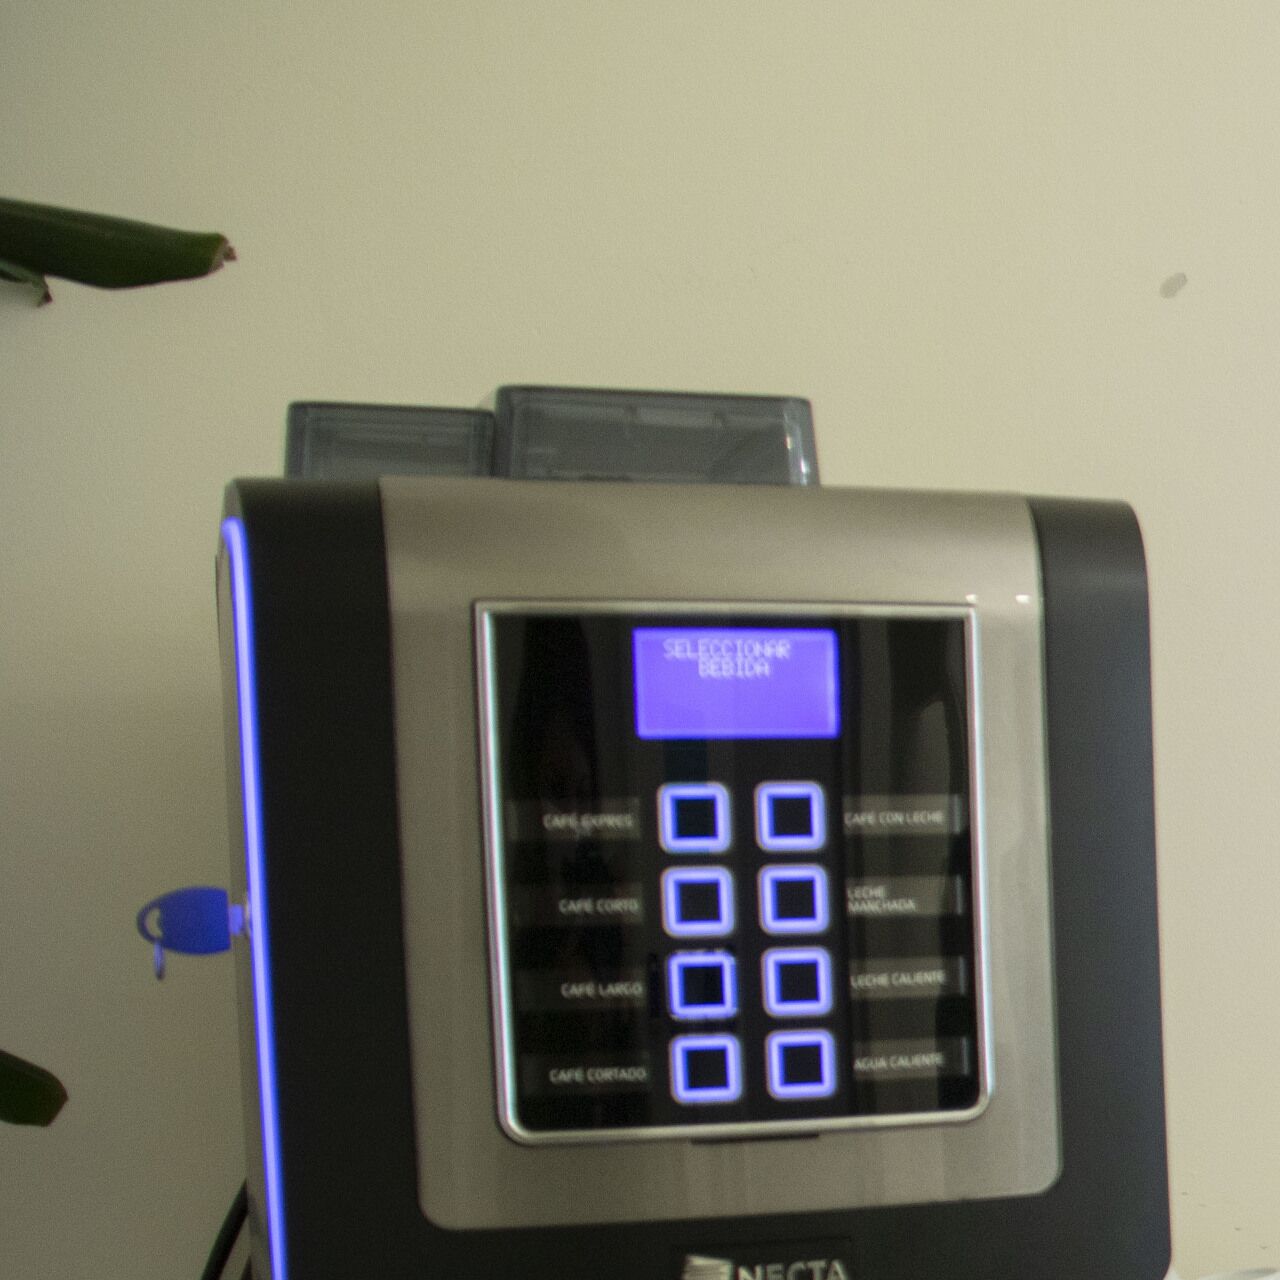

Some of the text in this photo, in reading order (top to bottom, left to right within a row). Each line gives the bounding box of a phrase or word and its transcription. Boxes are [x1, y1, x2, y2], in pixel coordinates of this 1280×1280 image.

[663, 638, 791, 659] SELECCIONAR
[699, 660, 770, 678] BEBIDA
[905, 810, 944, 823] LECHE
[596, 897, 639, 913] CORTO
[598, 981, 643, 997] LARGO
[586, 1067, 646, 1082] CORTADO
